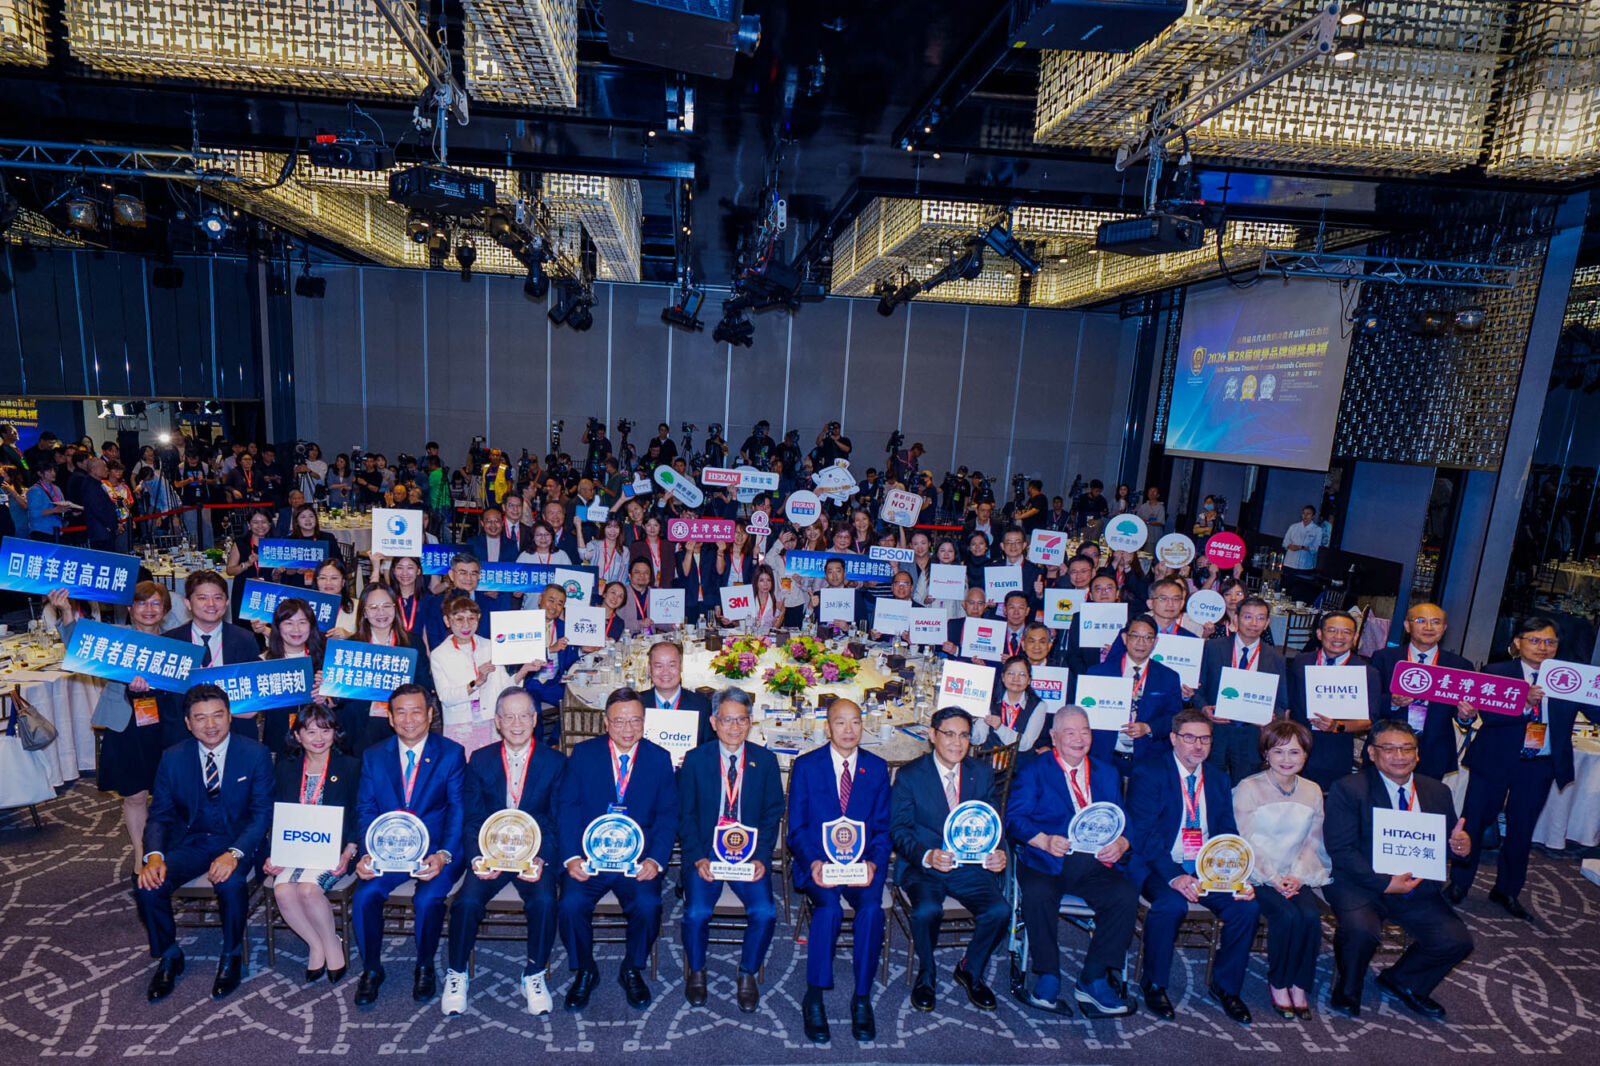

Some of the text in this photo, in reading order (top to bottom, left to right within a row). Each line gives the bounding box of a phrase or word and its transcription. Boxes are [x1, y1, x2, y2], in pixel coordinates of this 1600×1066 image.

[707, 472, 738, 482] HERAN
[891, 500, 915, 512] NO.1
[691, 523, 732, 534] 臺灣銀行
[1210, 541, 1242, 552] SANLUX
[871, 548, 914, 562] EPSON
[1209, 549, 1241, 559] 台灣三洋
[8, 552, 129, 592] 回購率超高品牌
[729, 596, 749, 609] 3M
[1200, 603, 1222, 613] Order
[76, 633, 194, 680] 消費者最有感品牌
[334, 649, 410, 673] 臺灣最具代表性的
[257, 669, 306, 697] 榮耀時刻
[1032, 680, 1061, 690] ERAN
[1315, 684, 1358, 694] CHIMEI
[1437, 673, 1521, 701] 臺灣銀行
[1434, 690, 1517, 710] BANK OF TAIWAN
[659, 731, 691, 741] Order
[283, 829, 331, 844] EPSON
[1383, 828, 1436, 842] HITACHI
[1382, 843, 1436, 860] 日立冷氣
